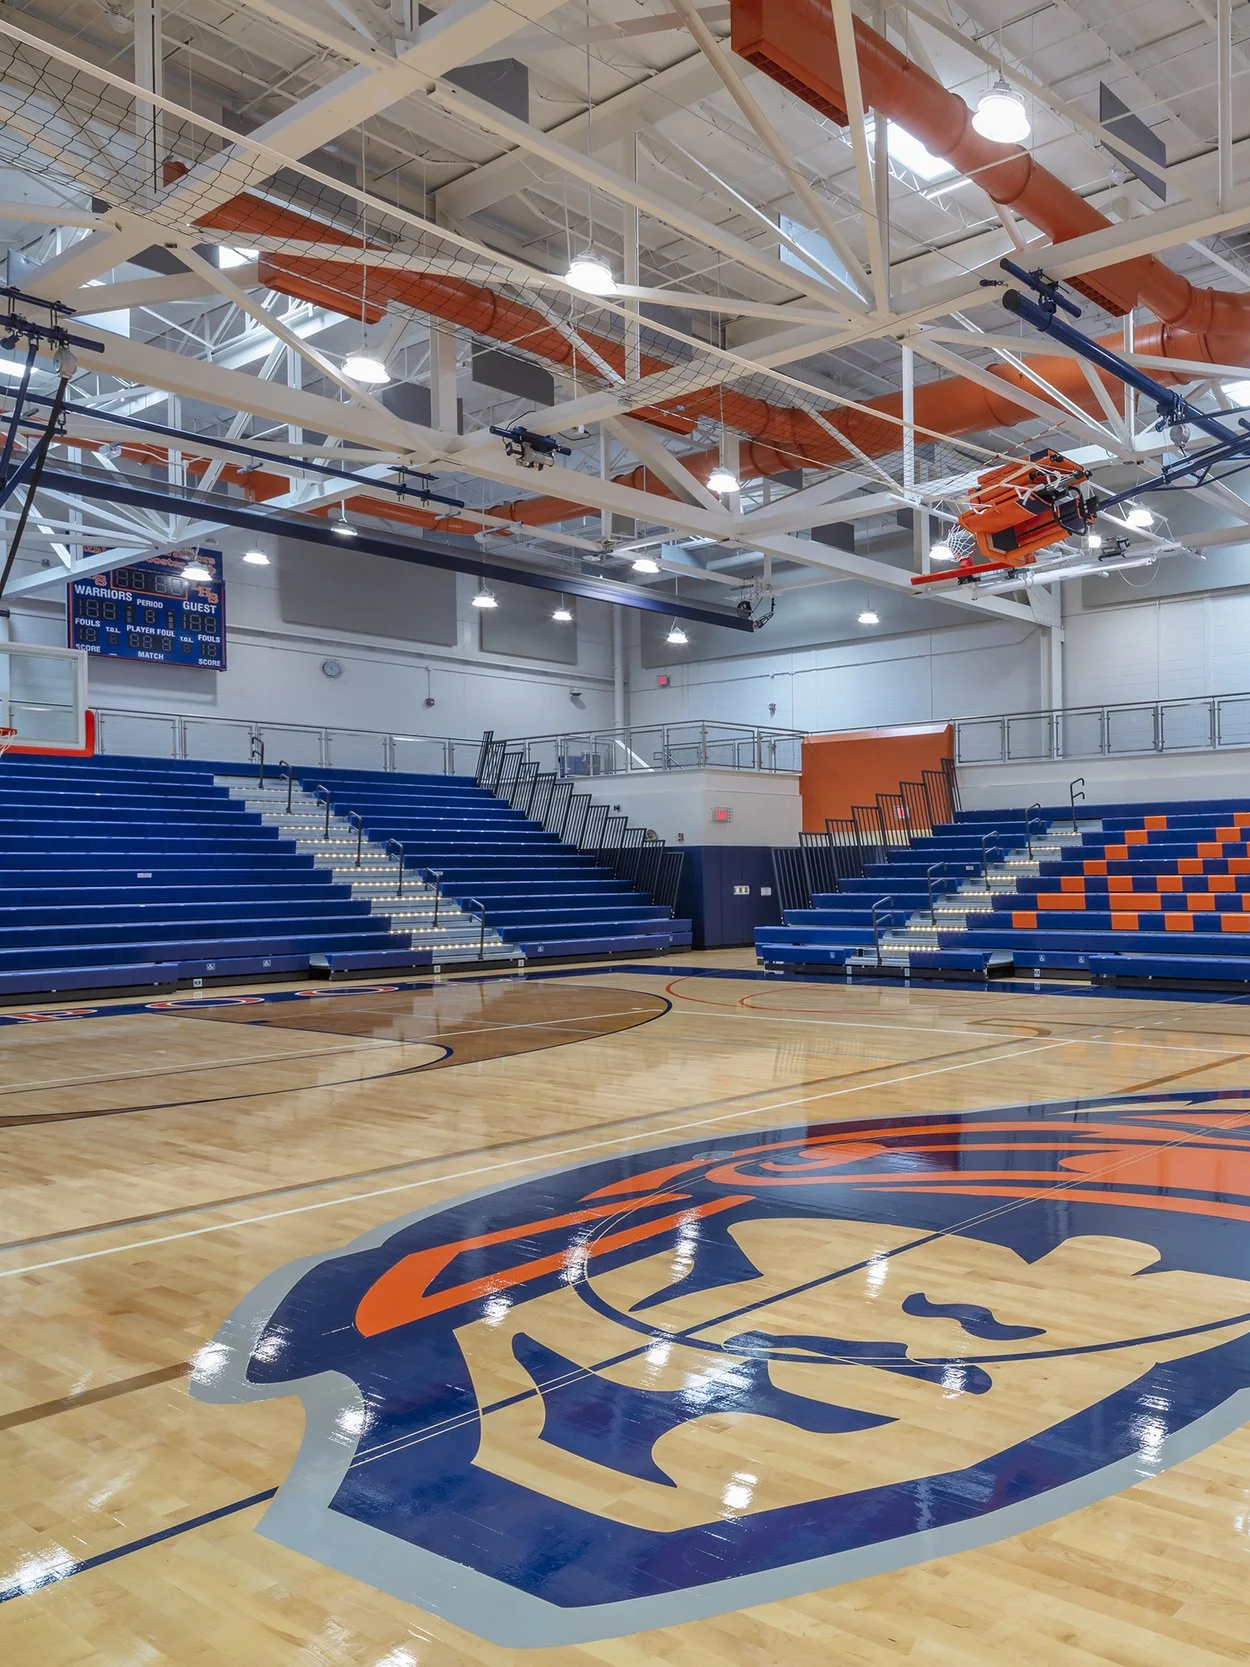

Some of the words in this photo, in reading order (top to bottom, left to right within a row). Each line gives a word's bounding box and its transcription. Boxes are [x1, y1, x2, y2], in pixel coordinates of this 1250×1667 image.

[74, 584, 133, 602] WARRIORS
[136, 598, 164, 609] PERIOD
[182, 600, 217, 614] GUEST
[75, 617, 101, 628] FOULS
[126, 624, 155, 635] PLAYER
[156, 628, 176, 638] FOUL
[198, 634, 221, 644] FOULS
[75, 643, 101, 653] SCORE
[138, 651, 164, 661] MATCH
[198, 658, 221, 667] SCORE
